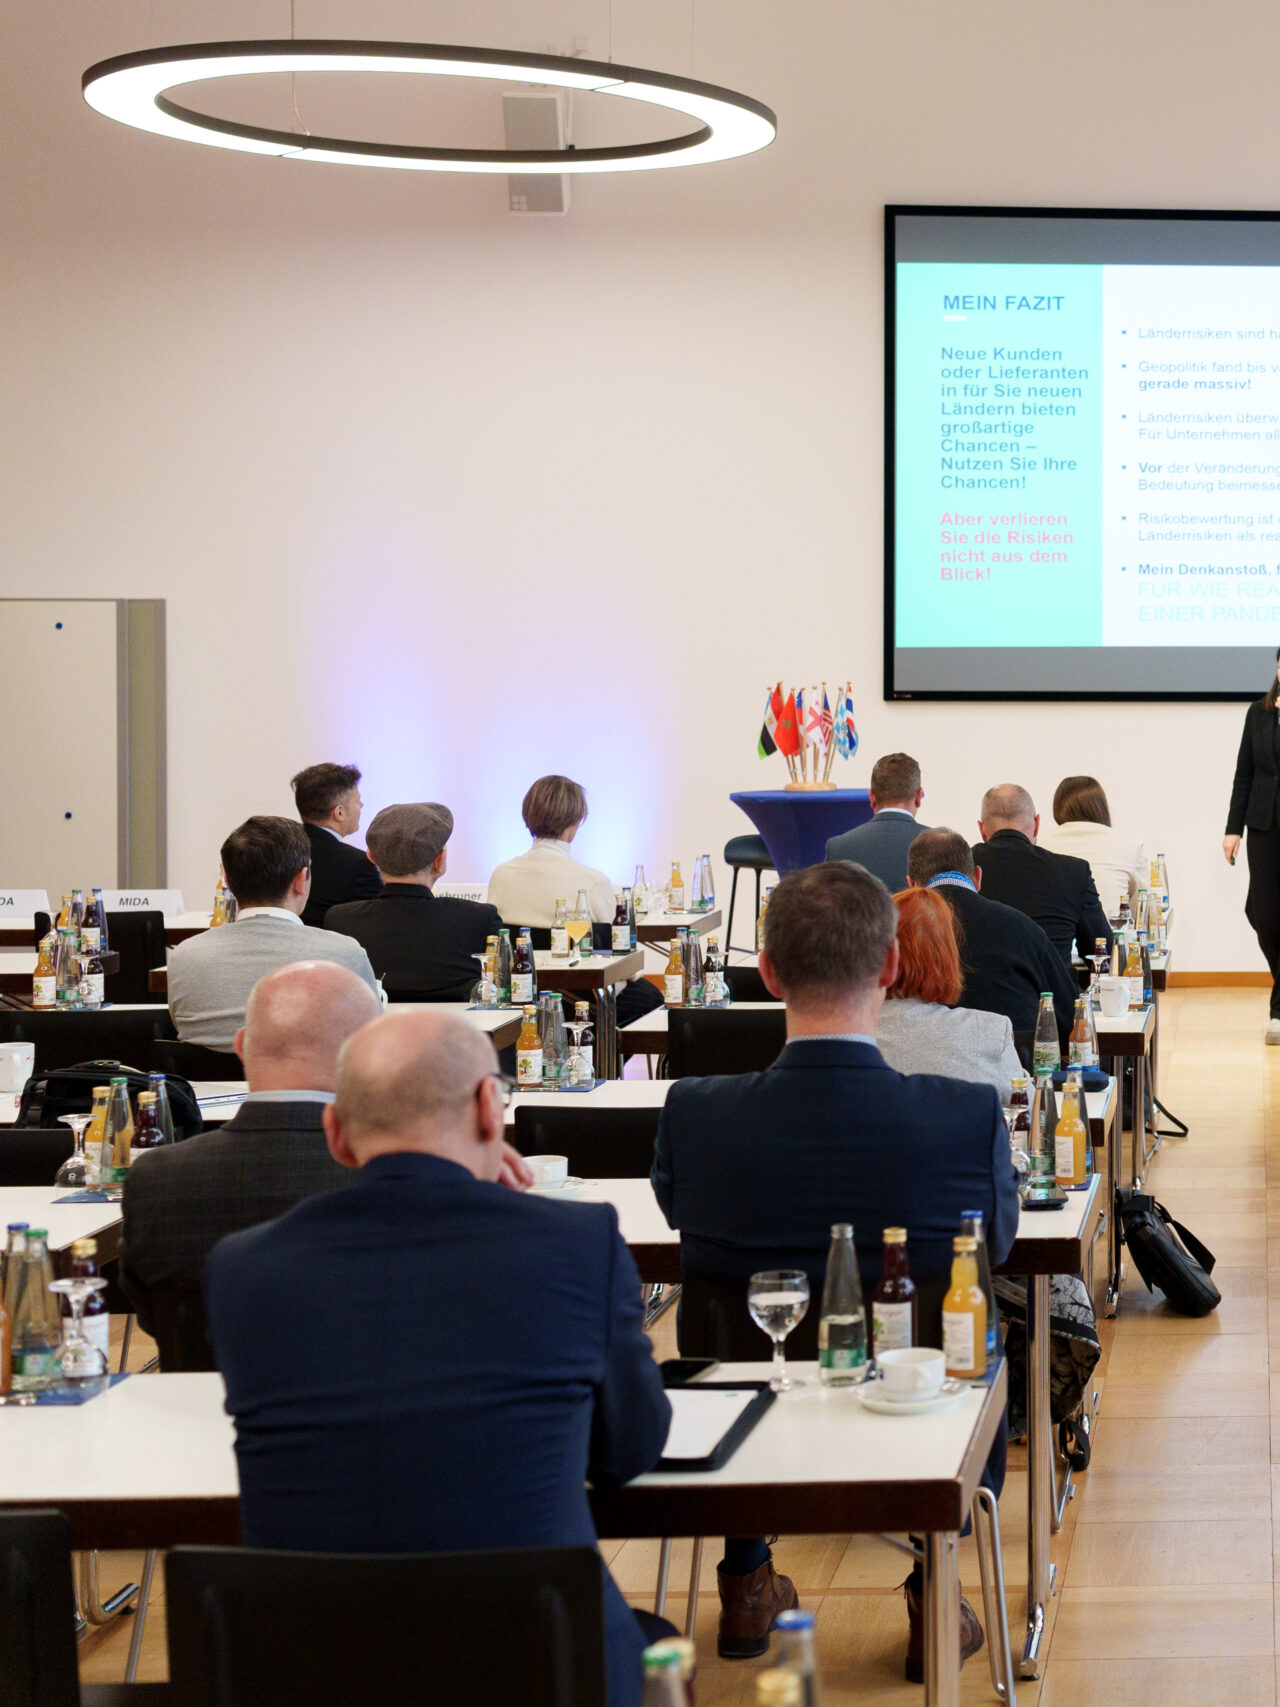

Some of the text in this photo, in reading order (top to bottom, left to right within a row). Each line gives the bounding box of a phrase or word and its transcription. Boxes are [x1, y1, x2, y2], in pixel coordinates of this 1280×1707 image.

[944, 295, 1064, 311] MEIN FAZIT
[1139, 328, 1232, 339] Länderrisiken
[1236, 328, 1265, 339] sind
[942, 347, 1062, 360] Neue Kunden
[941, 366, 1088, 379] oder Lieferanten
[1138, 361, 1207, 375] Geopolitik
[1212, 361, 1242, 372] fand
[1247, 362, 1267, 373] bis
[941, 384, 1082, 398] in für Sie neuen
[1139, 378, 1251, 391] gerade massiv!
[941, 402, 1076, 416] Ländern bieten
[1139, 412, 1232, 423] Länderrisiken
[941, 421, 1034, 437] großartige
[1138, 428, 1162, 440] Für
[1166, 429, 1260, 440] Unternehmen
[941, 439, 1020, 452] Chancen
[941, 457, 1077, 471] Nutzen Sie Ihre
[1138, 462, 1163, 473] Vor
[1168, 463, 1189, 473] der
[941, 475, 1026, 489] Chancen!
[1138, 479, 1214, 493] Bedeutung
[940, 512, 1067, 526] Aber verlieren
[1138, 512, 1254, 527] Risikobewertung
[1258, 514, 1274, 524] ist
[940, 531, 1073, 544] Sie die Risiken
[1138, 530, 1232, 541] Länderrisiken
[1236, 530, 1256, 541] als
[941, 550, 1067, 562] nicht aus dem
[940, 567, 990, 581] Blick!
[1139, 564, 1173, 575] Mein
[1179, 564, 1271, 577] Denkanstoß,
[1138, 579, 1181, 598] FÜR
[1189, 582, 1228, 598] WIE
[1138, 605, 1204, 622] EINER
[119, 897, 149, 906] MIDA
